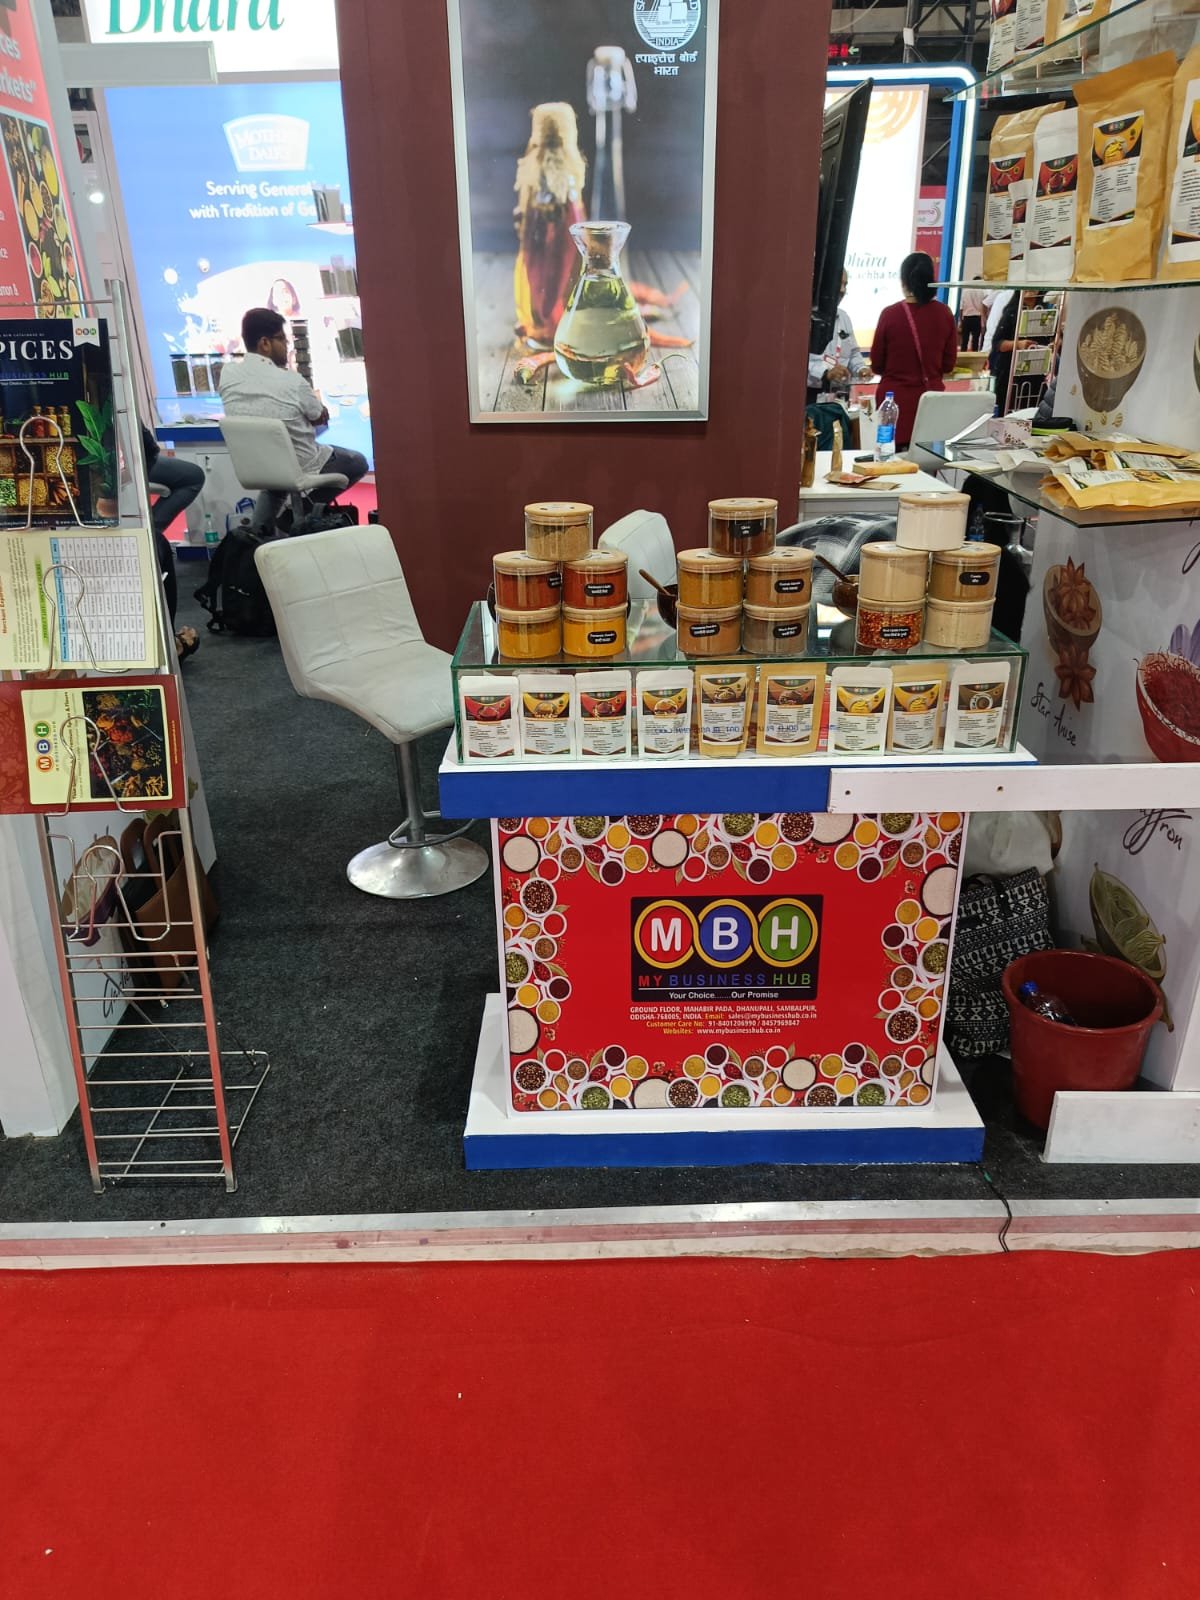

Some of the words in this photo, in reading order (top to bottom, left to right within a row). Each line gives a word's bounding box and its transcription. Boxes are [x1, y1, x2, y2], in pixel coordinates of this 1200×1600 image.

[655, 37, 680, 46] INDIA
[654, 66, 679, 75] भारत
[206, 181, 258, 199] Serving
[189, 203, 219, 219] with
[220, 203, 278, 218] Tradition
[281, 201, 295, 217] of
[1031, 682, 1051, 718] Star
[1054, 704, 1077, 746] Anise
[39, 724, 50, 769] MBH
[1123, 808, 1192, 855] ffron
[651, 915, 799, 951] MBH
[638, 975, 663, 987] MY
[669, 974, 766, 987] BUSINESS
[773, 973, 811, 985] HUB
[669, 991, 687, 999] Your
[747, 991, 779, 999] Promise
[684, 1005, 713, 1013] MAHABIR
[728, 1012, 817, 1020] sales@mybusinesshub.co.in
[697, 1027, 781, 1035] www.mybusinesshub.co.in
